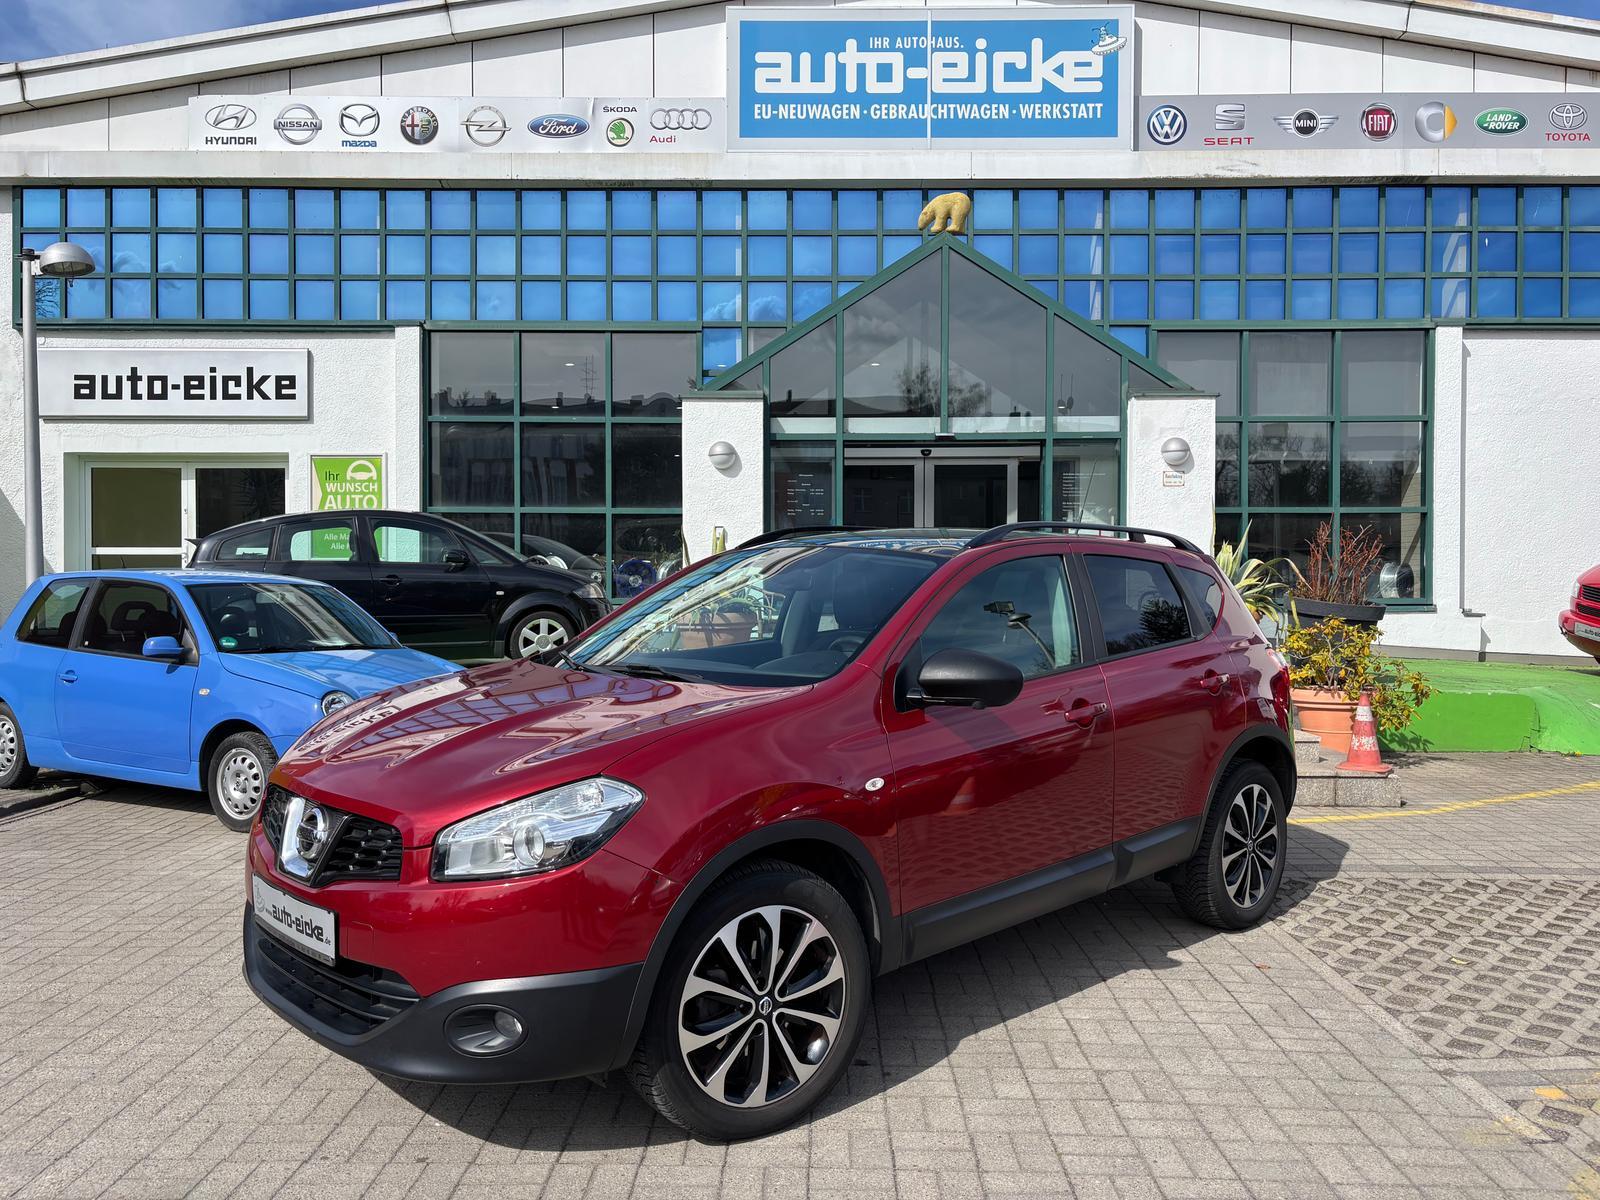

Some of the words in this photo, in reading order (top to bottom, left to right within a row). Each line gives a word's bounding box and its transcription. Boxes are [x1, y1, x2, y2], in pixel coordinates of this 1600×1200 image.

[869, 37, 890, 49] IHR
[895, 36, 965, 49] AUTOHAUS.
[754, 37, 1104, 94] auto-eicke
[754, 103, 860, 120] EU-NEUWAGEN
[870, 103, 1010, 120] GEBRAUCHTWAGEN
[1018, 103, 1104, 119] WERKSTATT
[278, 121, 318, 129] NISSAN
[538, 118, 578, 135] Ford
[1295, 119, 1317, 128] MINI
[1368, 114, 1390, 132] FIAT
[205, 136, 257, 145] HYUNDAI
[649, 135, 677, 143] Audi
[1203, 137, 1255, 146] SEAT
[1545, 132, 1591, 141] TOYOTA
[73, 366, 297, 400] auto-eicke
[325, 470, 340, 481] Ihr
[326, 482, 377, 492] WUNSCH
[324, 494, 378, 510] AUTO
[324, 533, 337, 541] Alle
